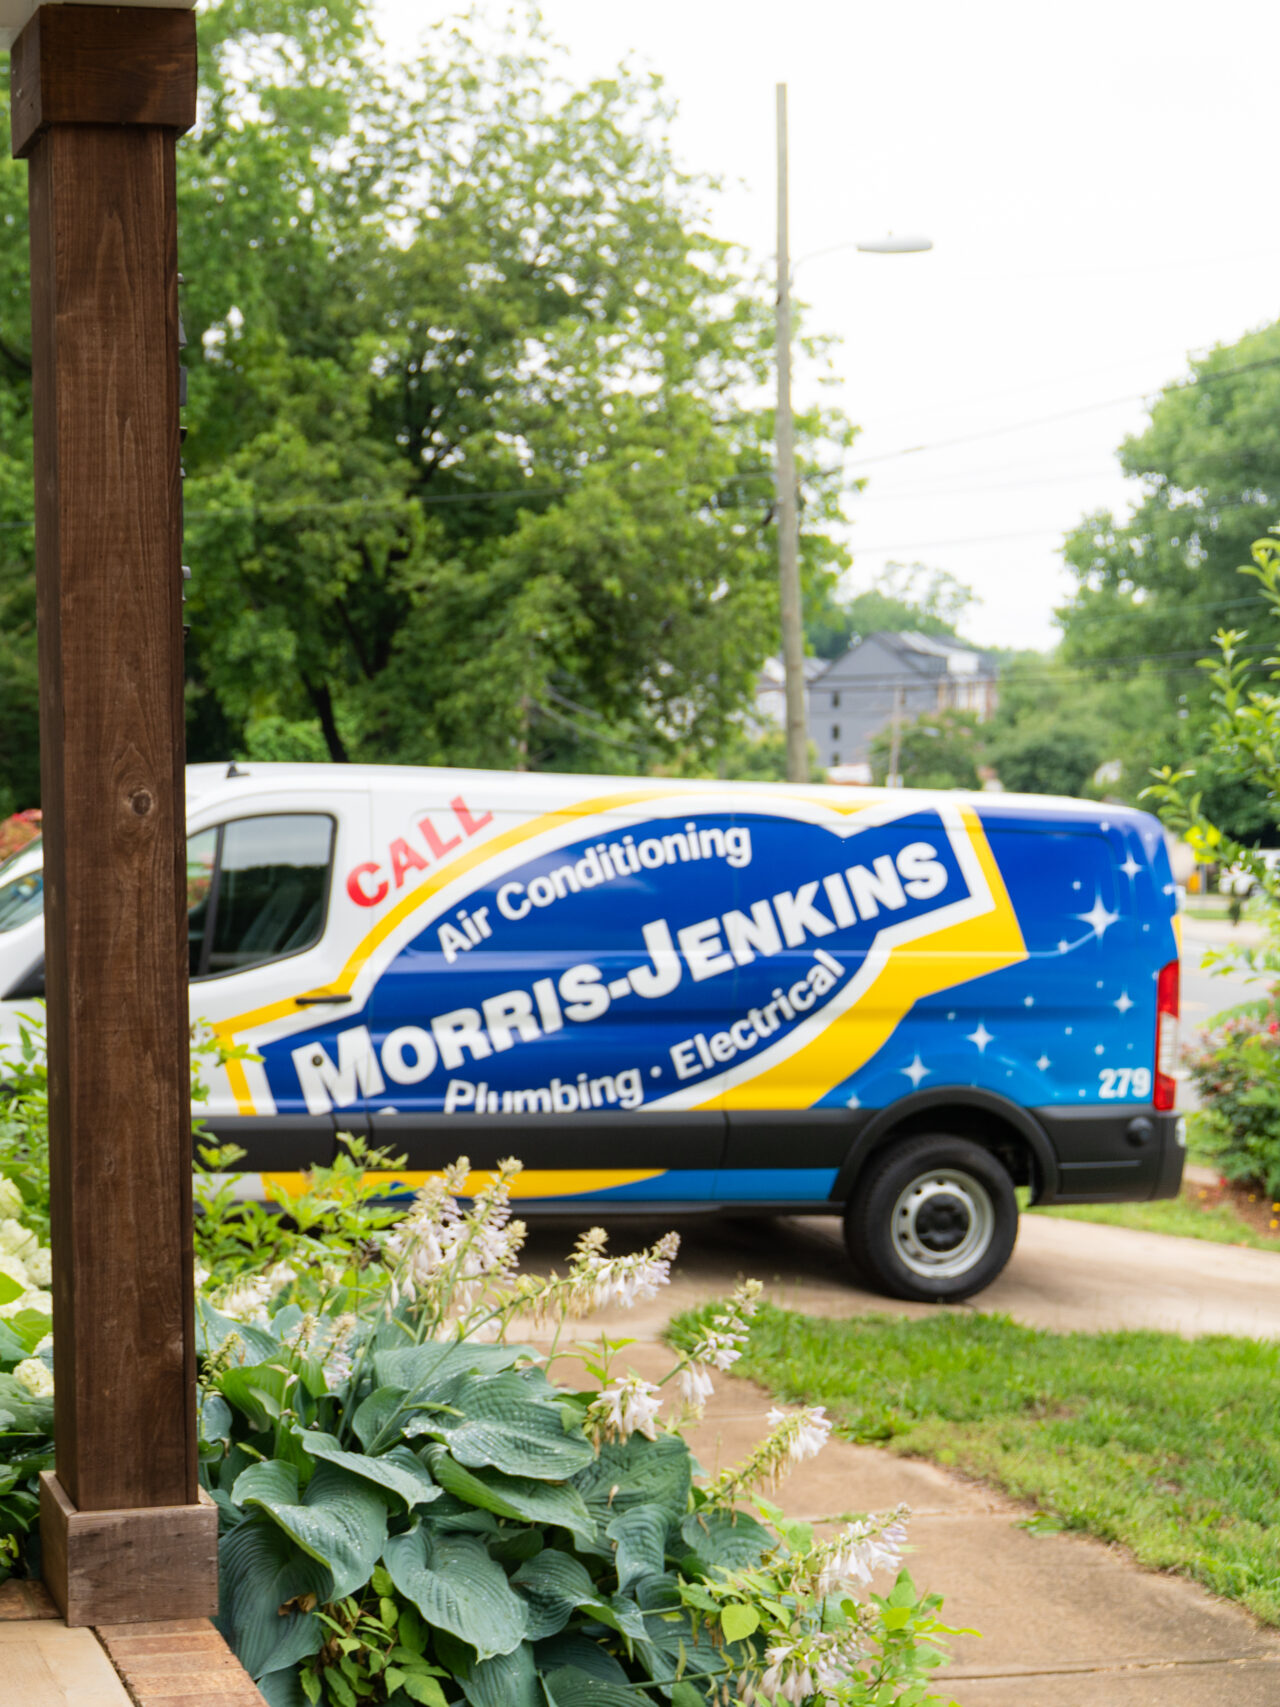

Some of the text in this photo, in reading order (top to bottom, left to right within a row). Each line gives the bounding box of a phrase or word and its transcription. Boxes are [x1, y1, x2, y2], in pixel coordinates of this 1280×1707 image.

[346, 796, 494, 908] CALL
[437, 822, 752, 964] Air Conditioning
[291, 842, 949, 1116] MORRIS-JENKINS
[444, 948, 846, 1113] Plumbing Electrical
[1098, 1067, 1151, 1099] 279
